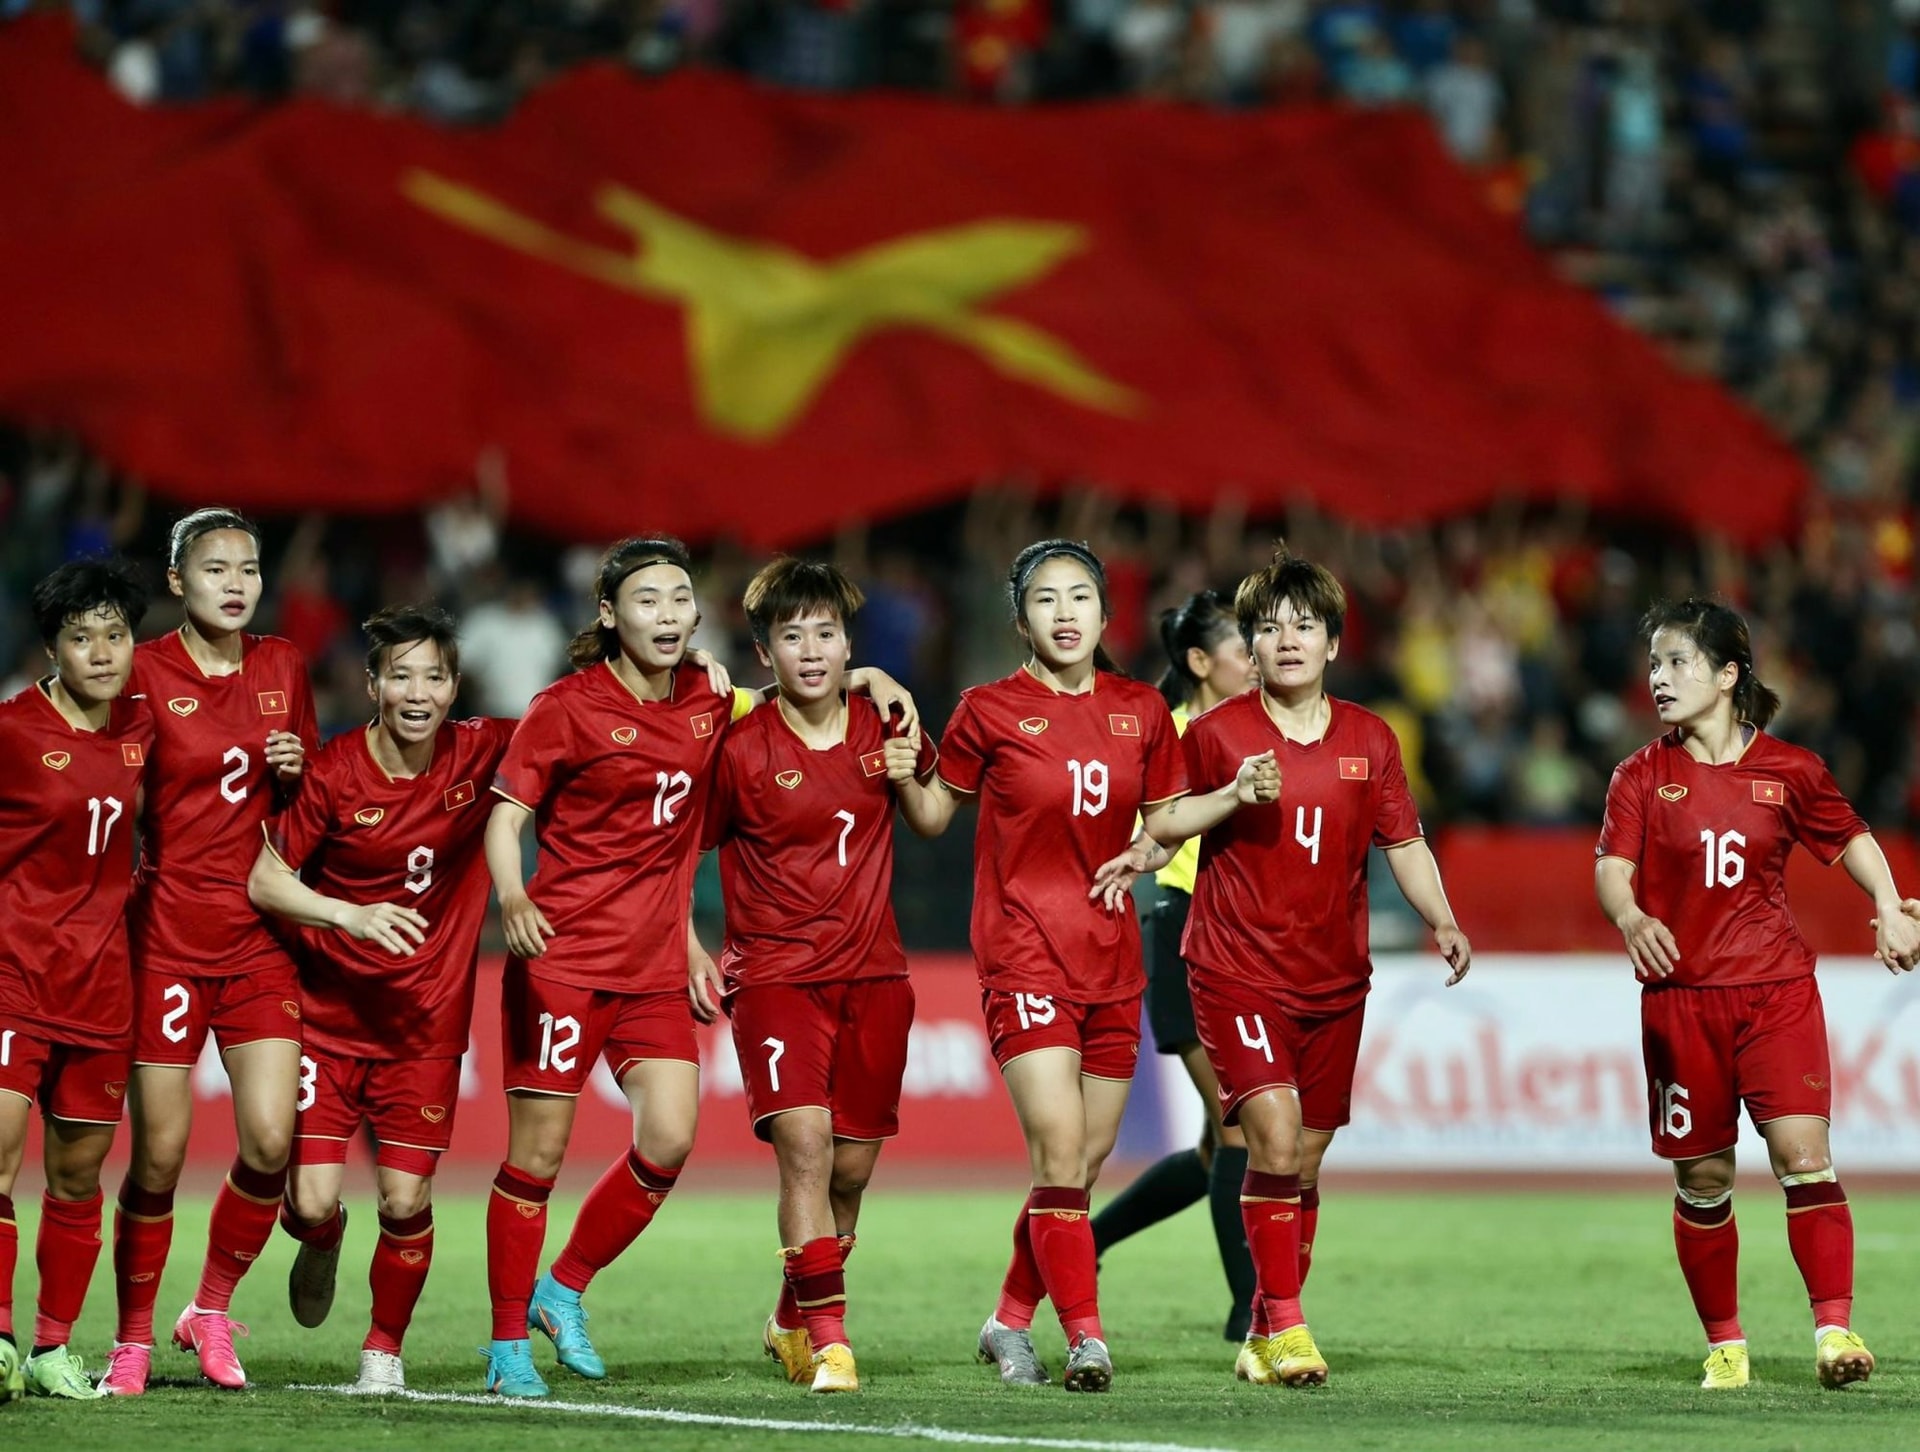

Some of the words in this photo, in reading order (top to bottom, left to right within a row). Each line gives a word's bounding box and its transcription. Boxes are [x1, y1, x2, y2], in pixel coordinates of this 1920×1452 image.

[220, 745, 250, 804] 2
[652, 769, 693, 827] 12
[1066, 758, 1109, 817] 19
[87, 796, 123, 855] 17
[832, 809, 856, 867] 7
[1294, 805, 1323, 865] 4
[404, 845, 434, 894] 8
[1699, 828, 1747, 889] 16
[161, 983, 190, 1043] 2
[538, 1011, 582, 1074] 12
[1235, 1013, 1275, 1064] 4
[761, 1036, 785, 1092] 7
[1655, 1078, 1693, 1140] 16
